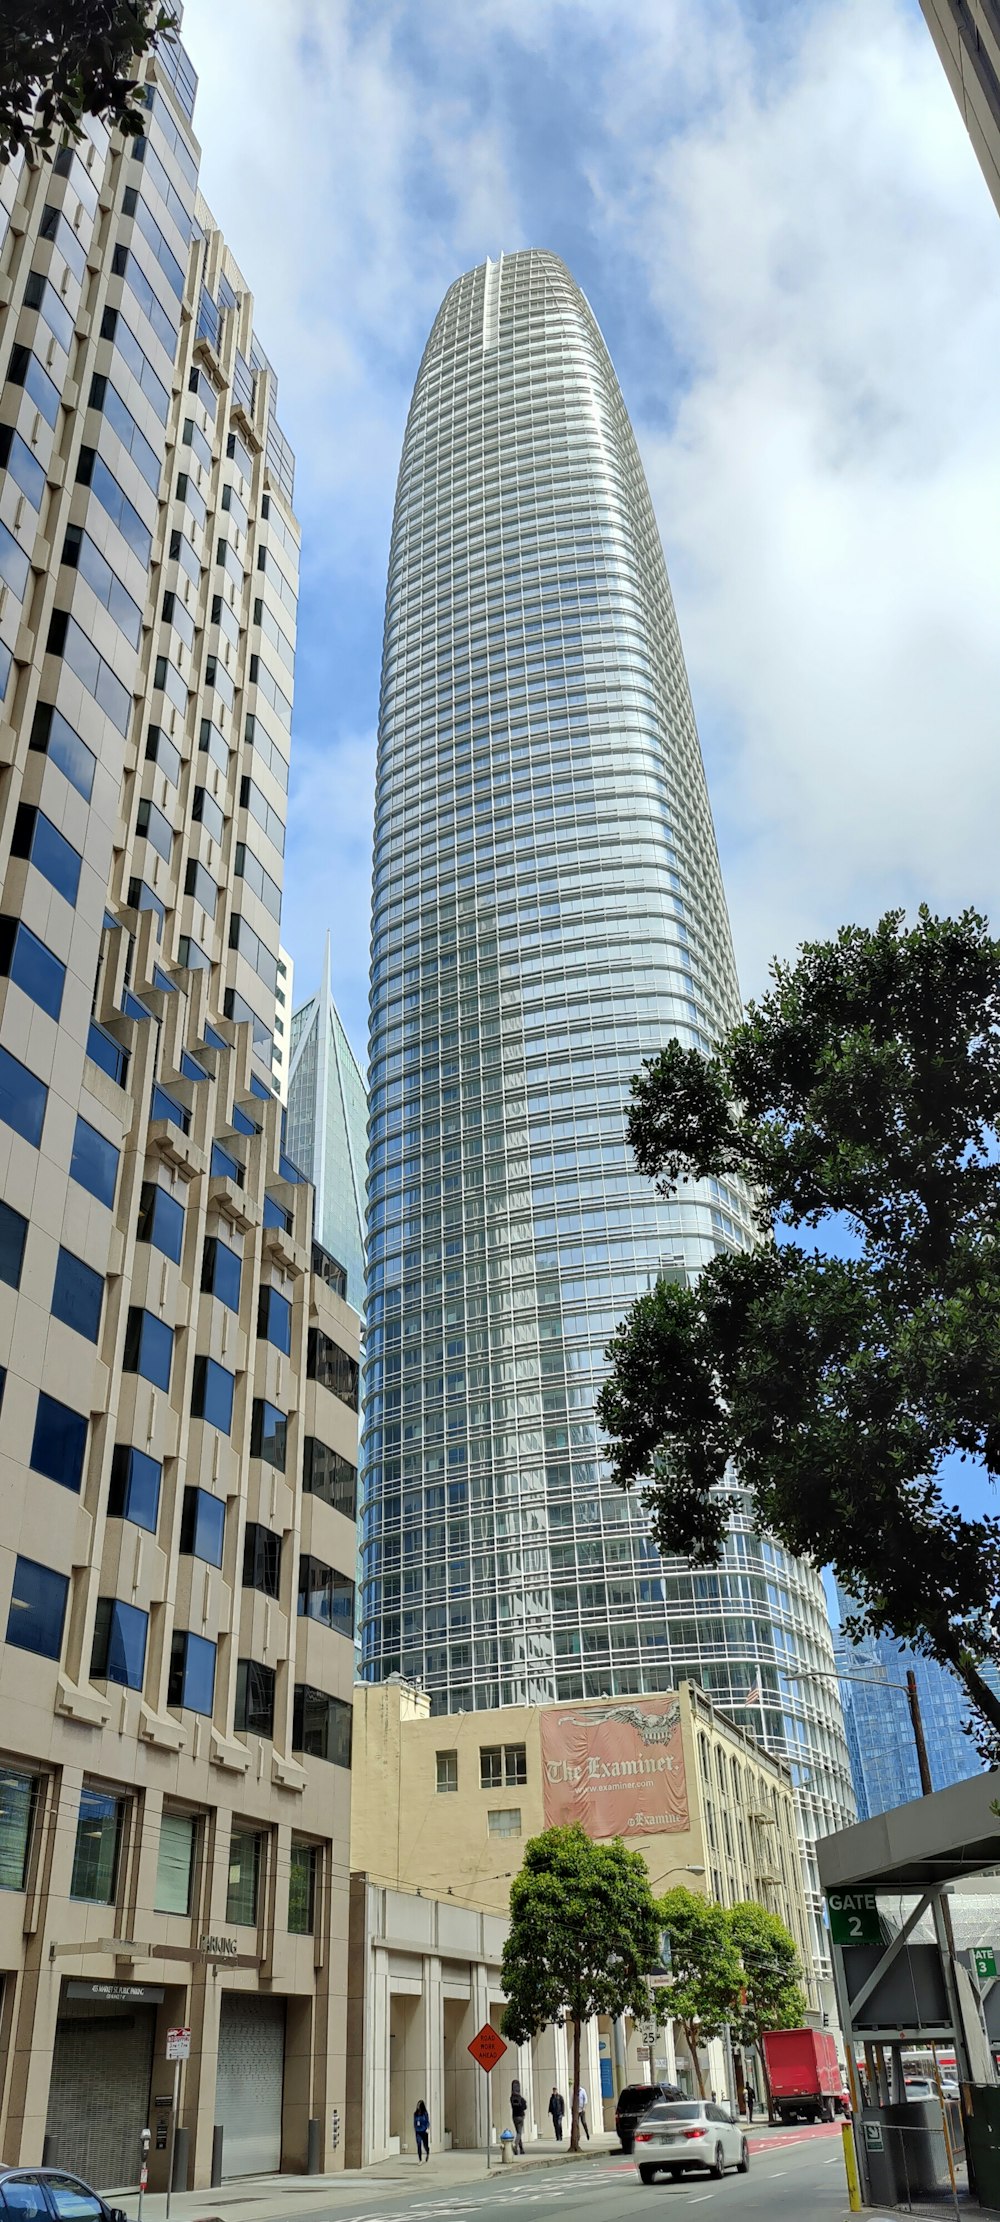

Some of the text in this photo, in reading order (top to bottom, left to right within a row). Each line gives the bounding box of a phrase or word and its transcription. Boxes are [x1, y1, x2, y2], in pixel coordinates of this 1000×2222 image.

[547, 1760, 581, 1784] The
[575, 1780, 654, 1794] www.examiner.com
[829, 1894, 876, 1910] GATE
[848, 1916, 863, 1937] 2
[201, 1934, 238, 1955] PARKING
[974, 1950, 994, 1959] ATE
[979, 1961, 987, 1973] 3
[643, 2032, 655, 2043] 25
